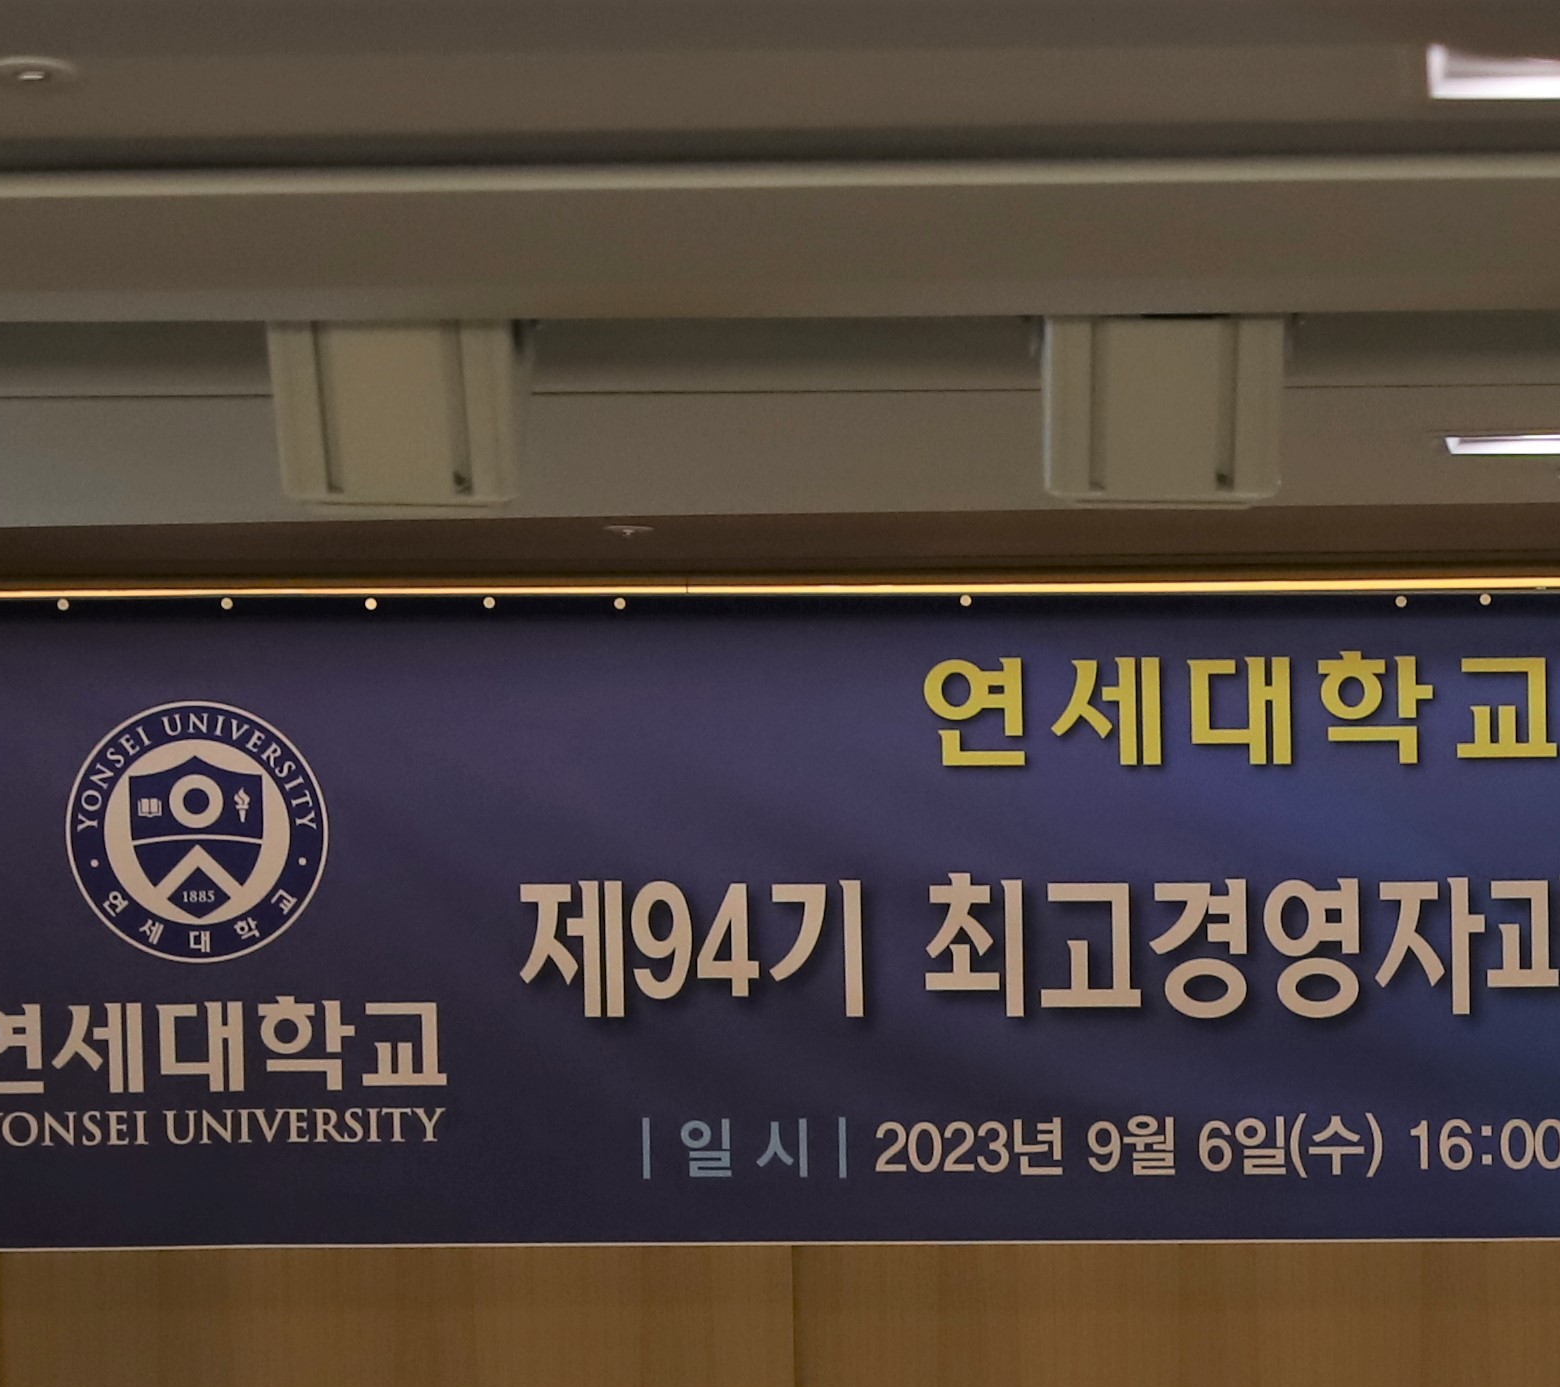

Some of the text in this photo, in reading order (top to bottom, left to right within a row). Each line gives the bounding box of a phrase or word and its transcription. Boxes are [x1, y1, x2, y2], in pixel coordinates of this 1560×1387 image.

[924, 651, 1557, 765] 연세대학교
[77, 712, 317, 832] YONSEI UNIVERSITY
[102, 889, 298, 953] 연세대학교
[182, 890, 216, 903] 1885
[520, 880, 863, 1017] 제94기
[164, 1108, 444, 1144] UNIVERSITY
[876, 1118, 1062, 1174] 2023년
[1088, 1116, 1175, 1175] 9월
[1199, 1113, 1382, 1177] 6일(수)
